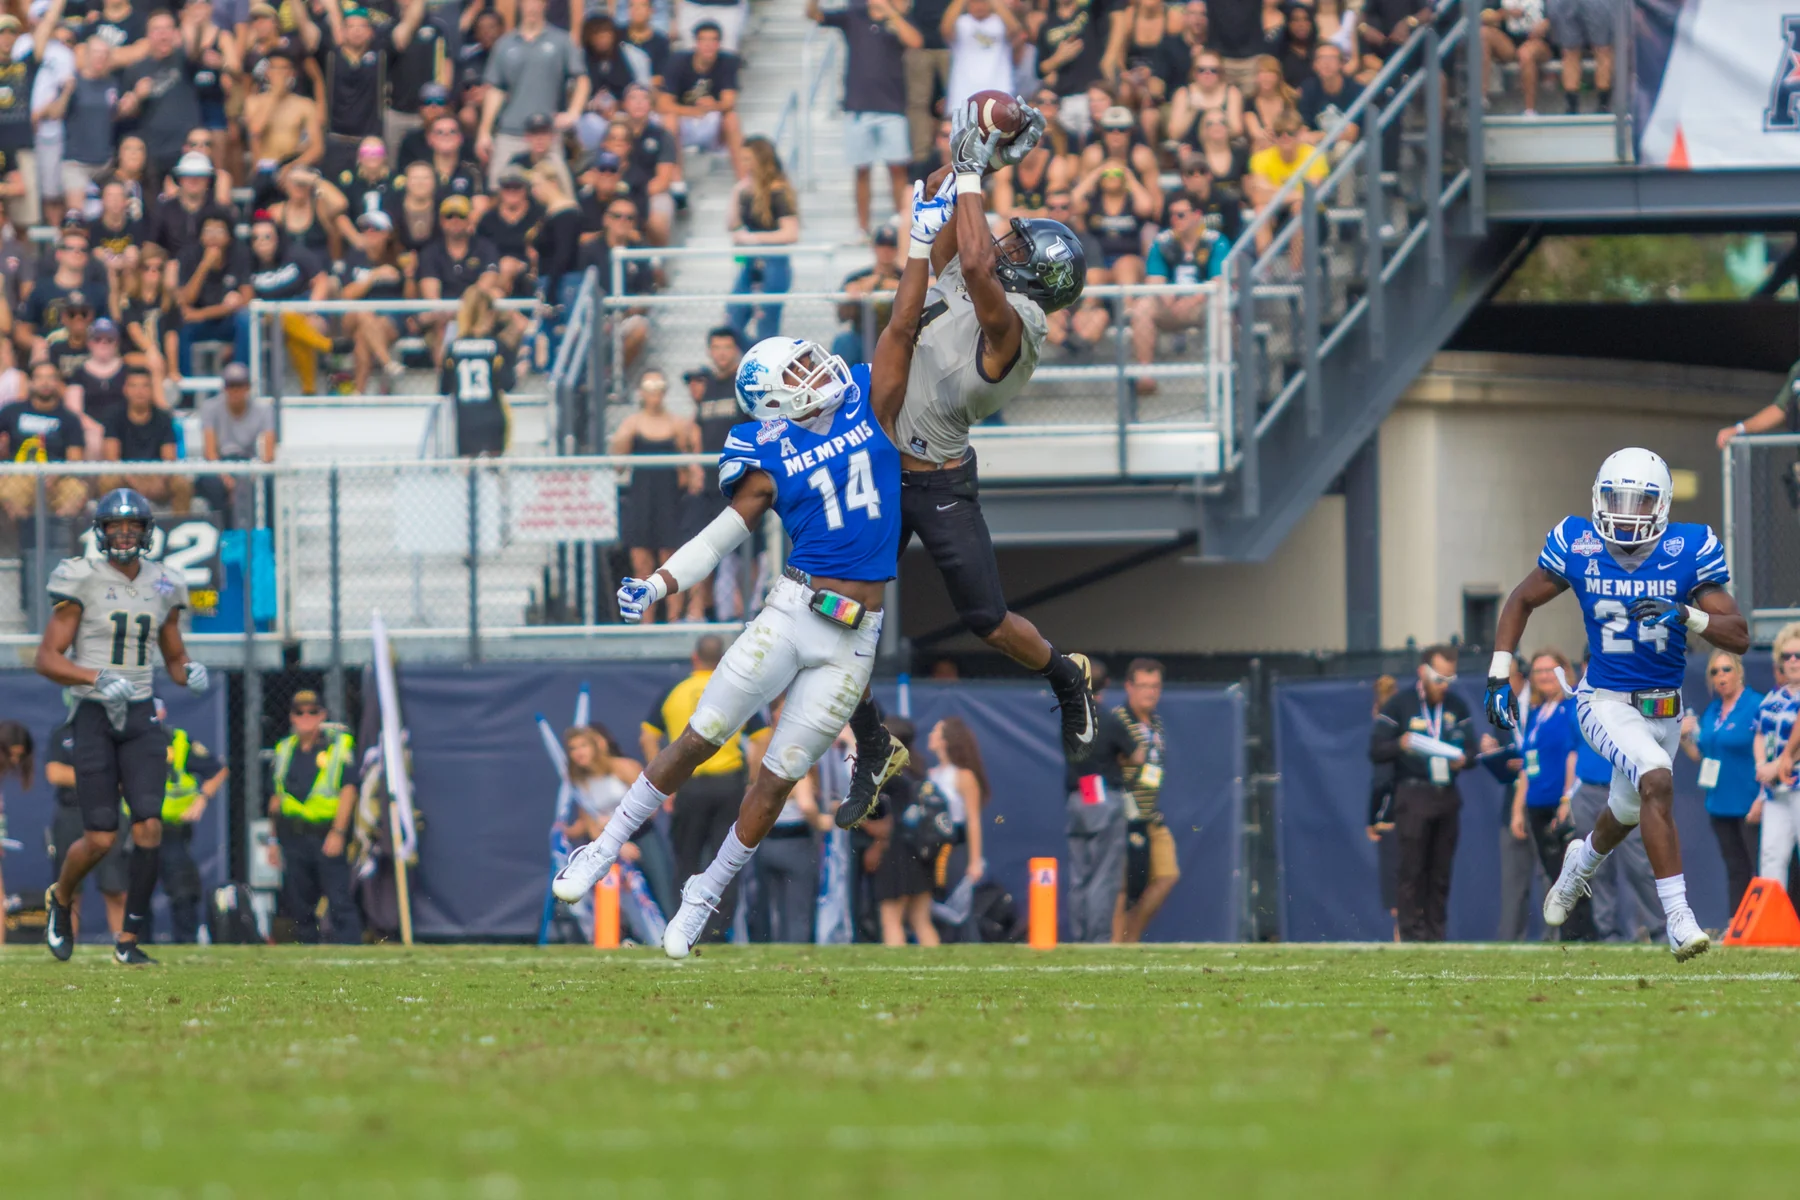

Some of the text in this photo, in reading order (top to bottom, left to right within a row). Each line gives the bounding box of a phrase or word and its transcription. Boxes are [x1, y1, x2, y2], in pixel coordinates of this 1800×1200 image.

[457, 357, 492, 402] 13
[782, 419, 874, 477] MEMPHIS
[807, 447, 882, 531] 14
[1584, 577, 1677, 596] MEMPHIS
[109, 610, 155, 667] 11
[1593, 599, 1669, 655] 24
